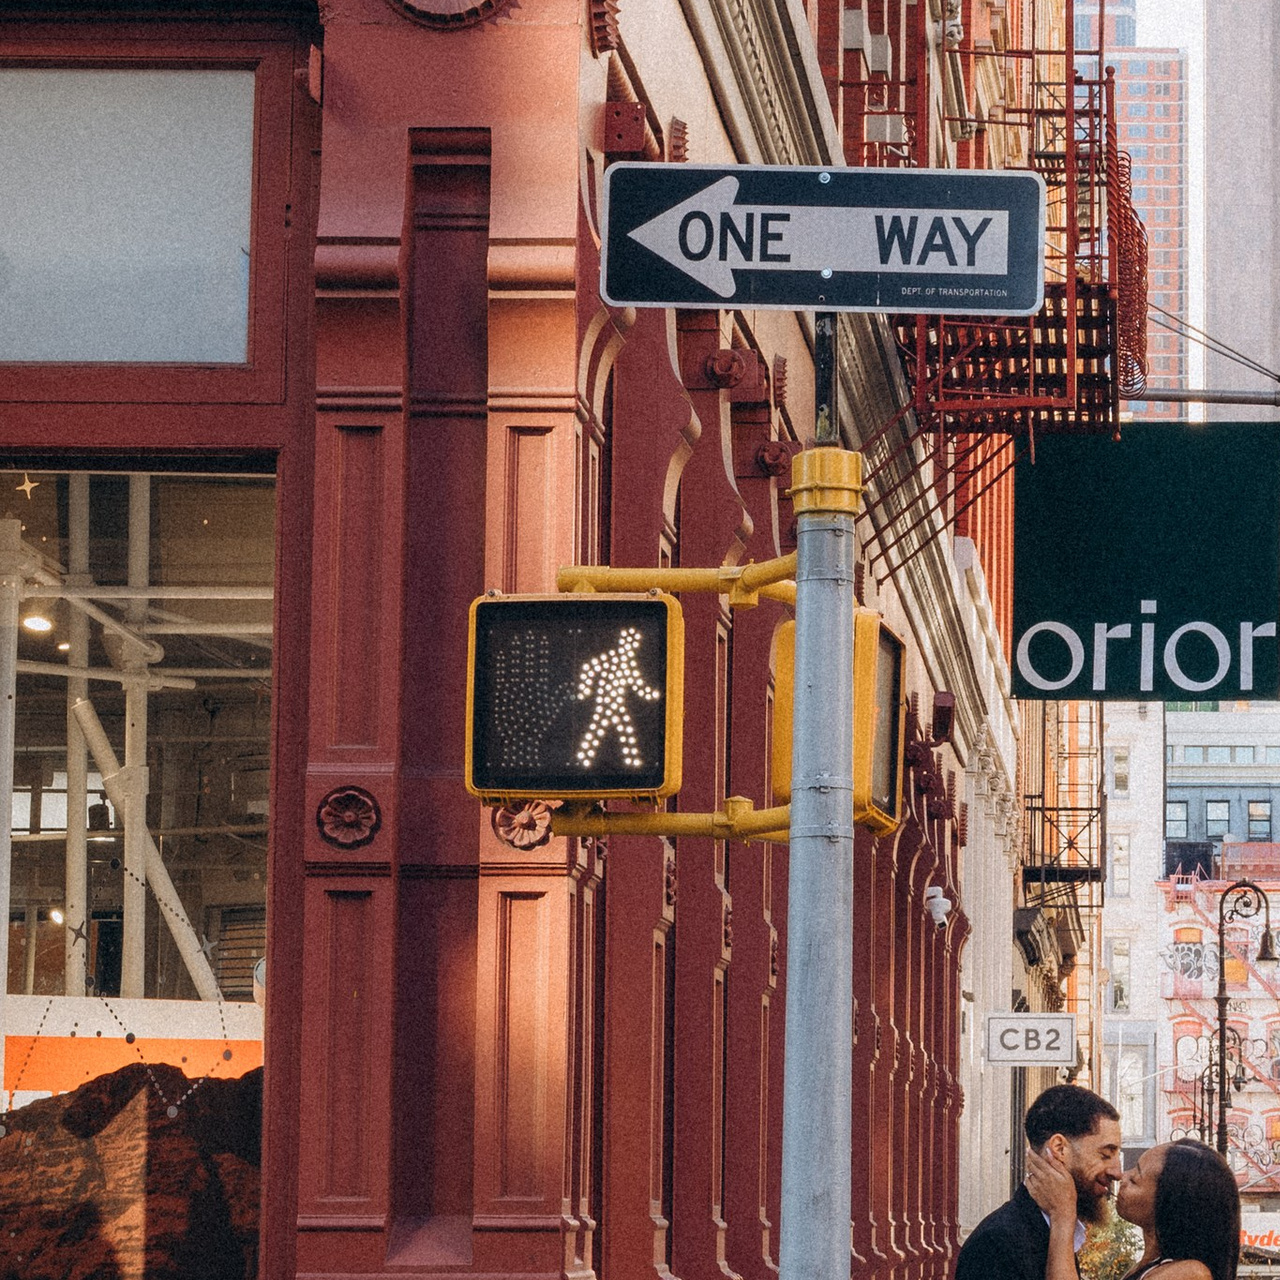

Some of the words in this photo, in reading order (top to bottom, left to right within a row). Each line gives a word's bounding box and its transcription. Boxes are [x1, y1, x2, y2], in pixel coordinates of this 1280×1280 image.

[678, 210, 791, 262] ONE
[875, 215, 993, 267] WAY
[925, 287, 936, 296] OF
[938, 288, 1008, 297] TRANSPORTATION
[1016, 600, 1277, 691] orior
[1000, 1028, 1060, 1051] CB2
